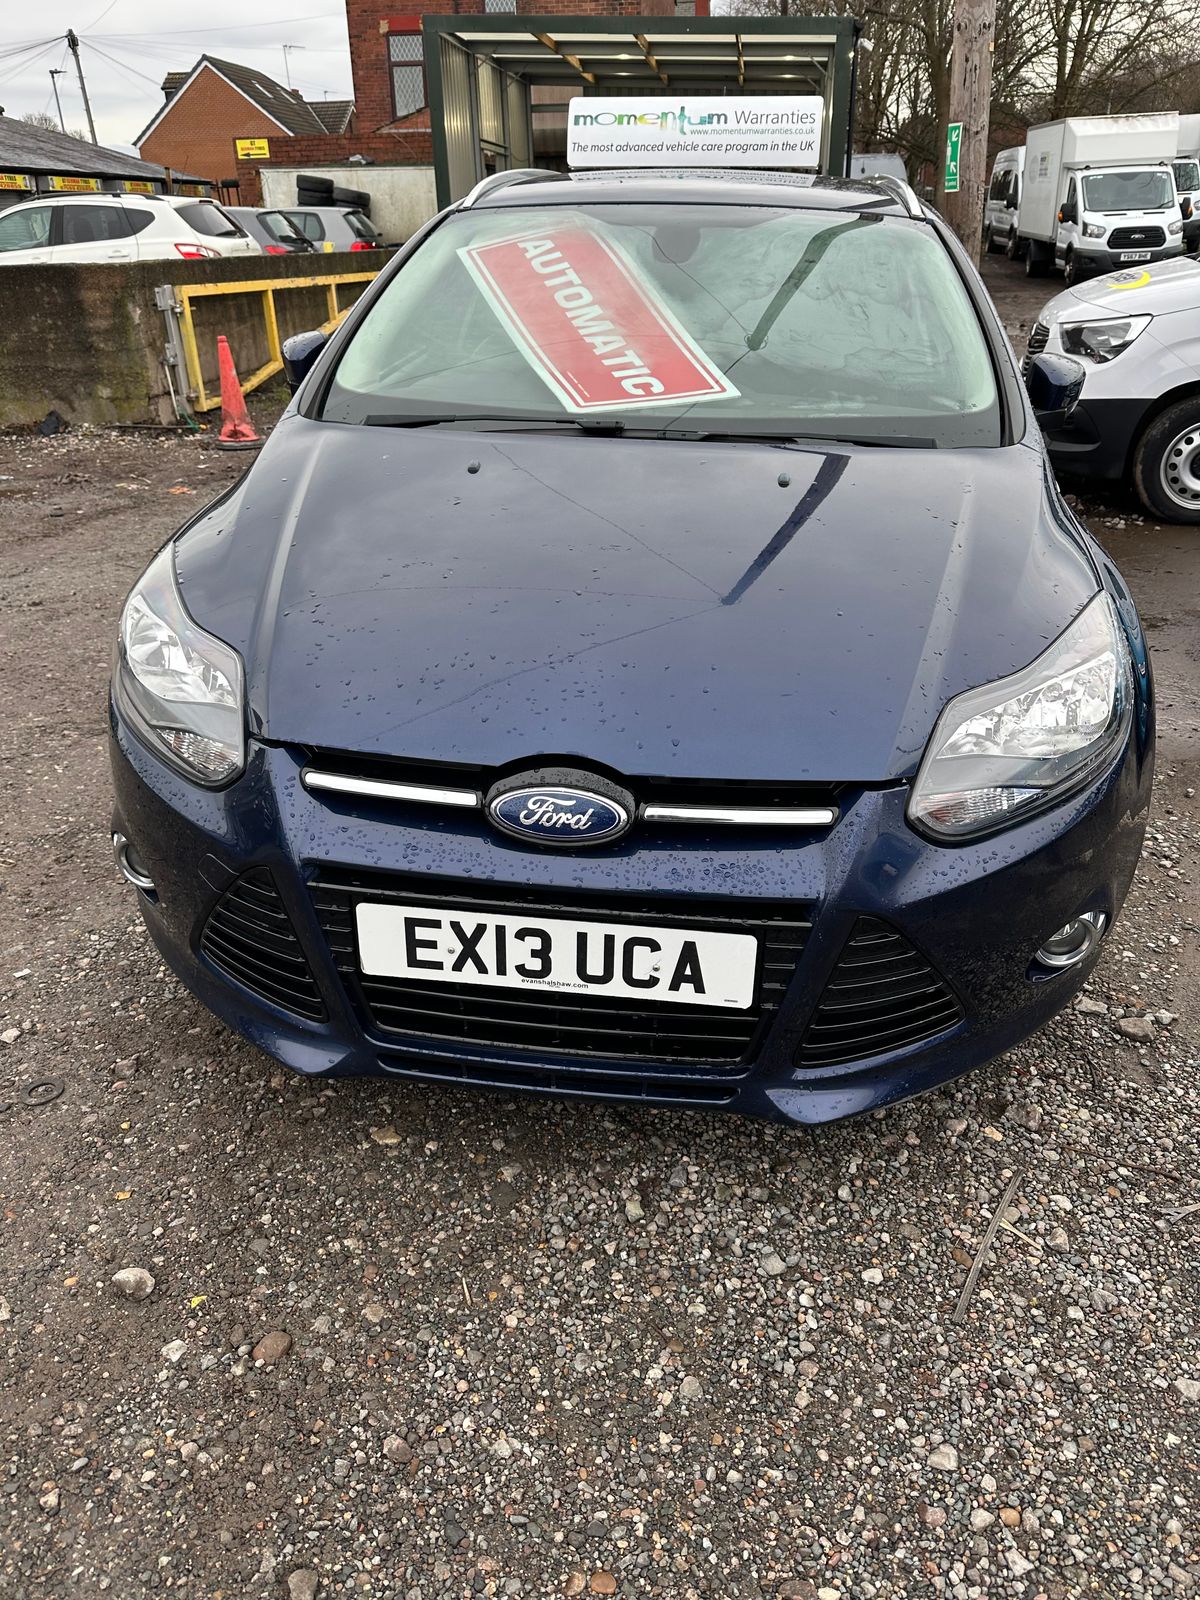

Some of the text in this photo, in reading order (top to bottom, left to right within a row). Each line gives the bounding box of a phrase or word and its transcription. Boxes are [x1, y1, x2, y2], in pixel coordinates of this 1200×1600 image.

[573, 106, 816, 135] momentum Warranties
[689, 126, 815, 136] www.momentumwarranties.co.uk
[572, 141, 815, 154] The most advanced vehicle care program in the UK
[517, 238, 665, 397] AUTOMATIC
[519, 795, 595, 830] Ford
[404, 916, 706, 994] EX13 UCA
[521, 978, 589, 989] evanshalshaw.com
